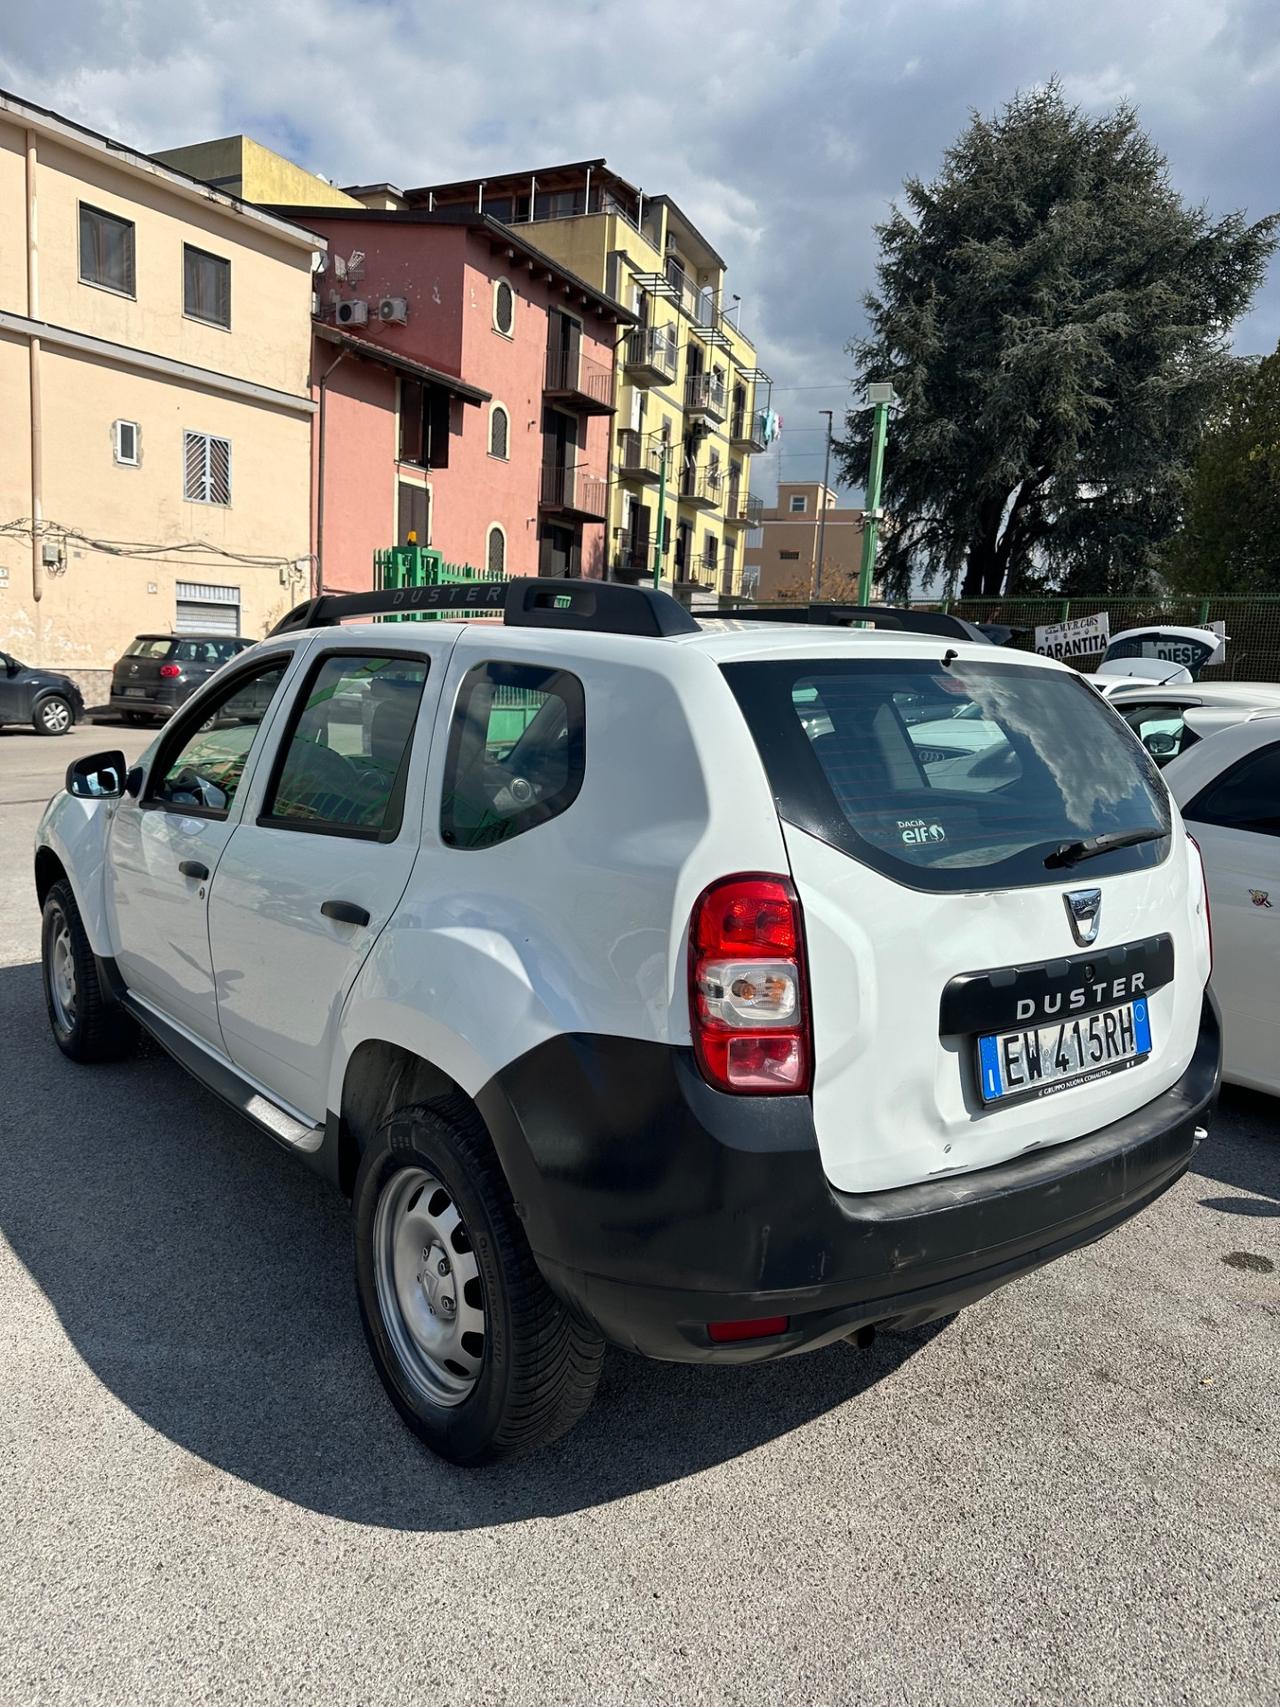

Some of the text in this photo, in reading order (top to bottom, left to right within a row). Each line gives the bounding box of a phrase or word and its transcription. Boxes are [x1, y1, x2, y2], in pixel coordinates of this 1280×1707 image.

[393, 587, 501, 604] DUSTER
[1037, 634, 1107, 659] GARANTITA
[897, 819, 926, 829] DACIA
[902, 827, 928, 843] elf
[1016, 972, 1145, 1020] DUSTER
[1044, 1083, 1066, 1095] GRUPPO
